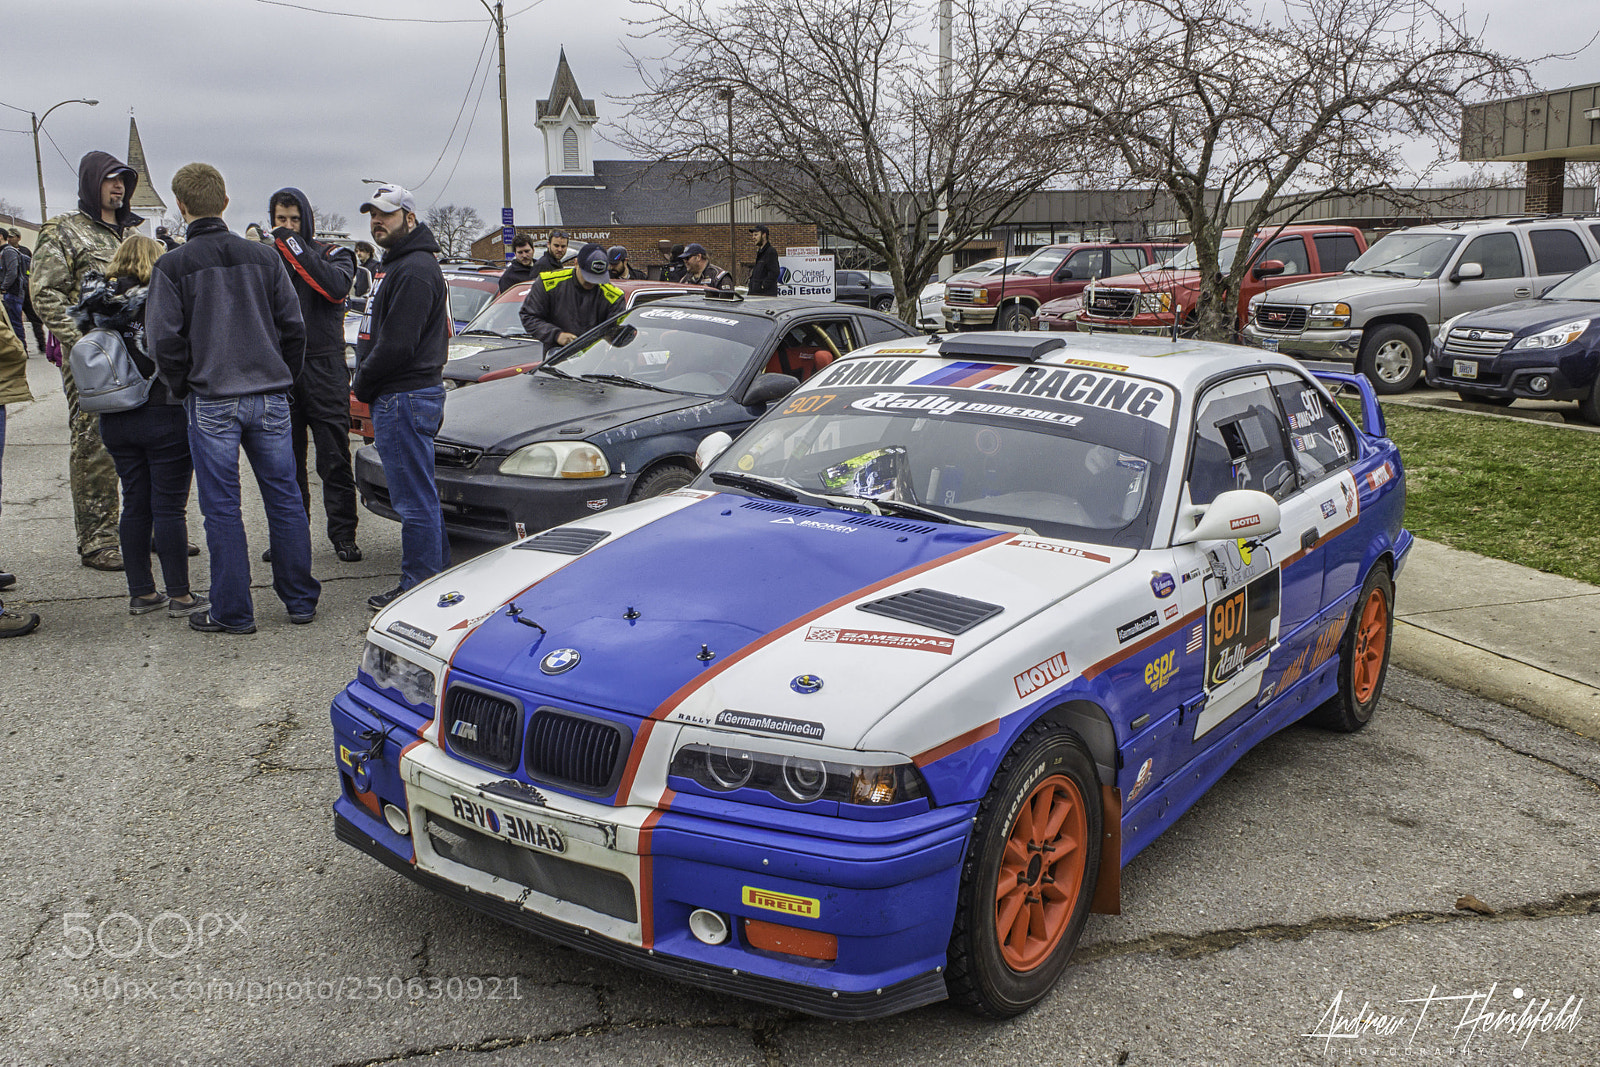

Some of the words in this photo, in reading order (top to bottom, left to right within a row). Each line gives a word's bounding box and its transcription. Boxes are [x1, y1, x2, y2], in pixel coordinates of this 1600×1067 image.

[573, 231, 611, 240] LIBRARY
[792, 269, 831, 283] Country
[799, 287, 832, 295] Estate
[1268, 312, 1287, 321] GMC
[816, 359, 918, 388] BMW
[782, 393, 837, 415] 907
[1008, 366, 1164, 419] RACING
[856, 391, 965, 415] Rally
[966, 402, 1085, 427] AMERICA
[1300, 388, 1324, 422] 907
[800, 519, 859, 533] BROKEN
[1231, 516, 1260, 529] MOTUL
[1018, 540, 1087, 557] MOTUL
[1213, 591, 1245, 646] 907
[839, 637, 922, 647] MOTORSPORT
[841, 632, 954, 648] SAMSONAS
[1144, 648, 1176, 689] espr
[1215, 642, 1247, 679] Rally
[1017, 656, 1068, 697] MOTUL
[677, 713, 712, 725] RALLY
[717, 711, 824, 737] #GermanMachineGun
[1000, 760, 1046, 838] MICHELIN
[748, 889, 814, 915] PIRELLI
